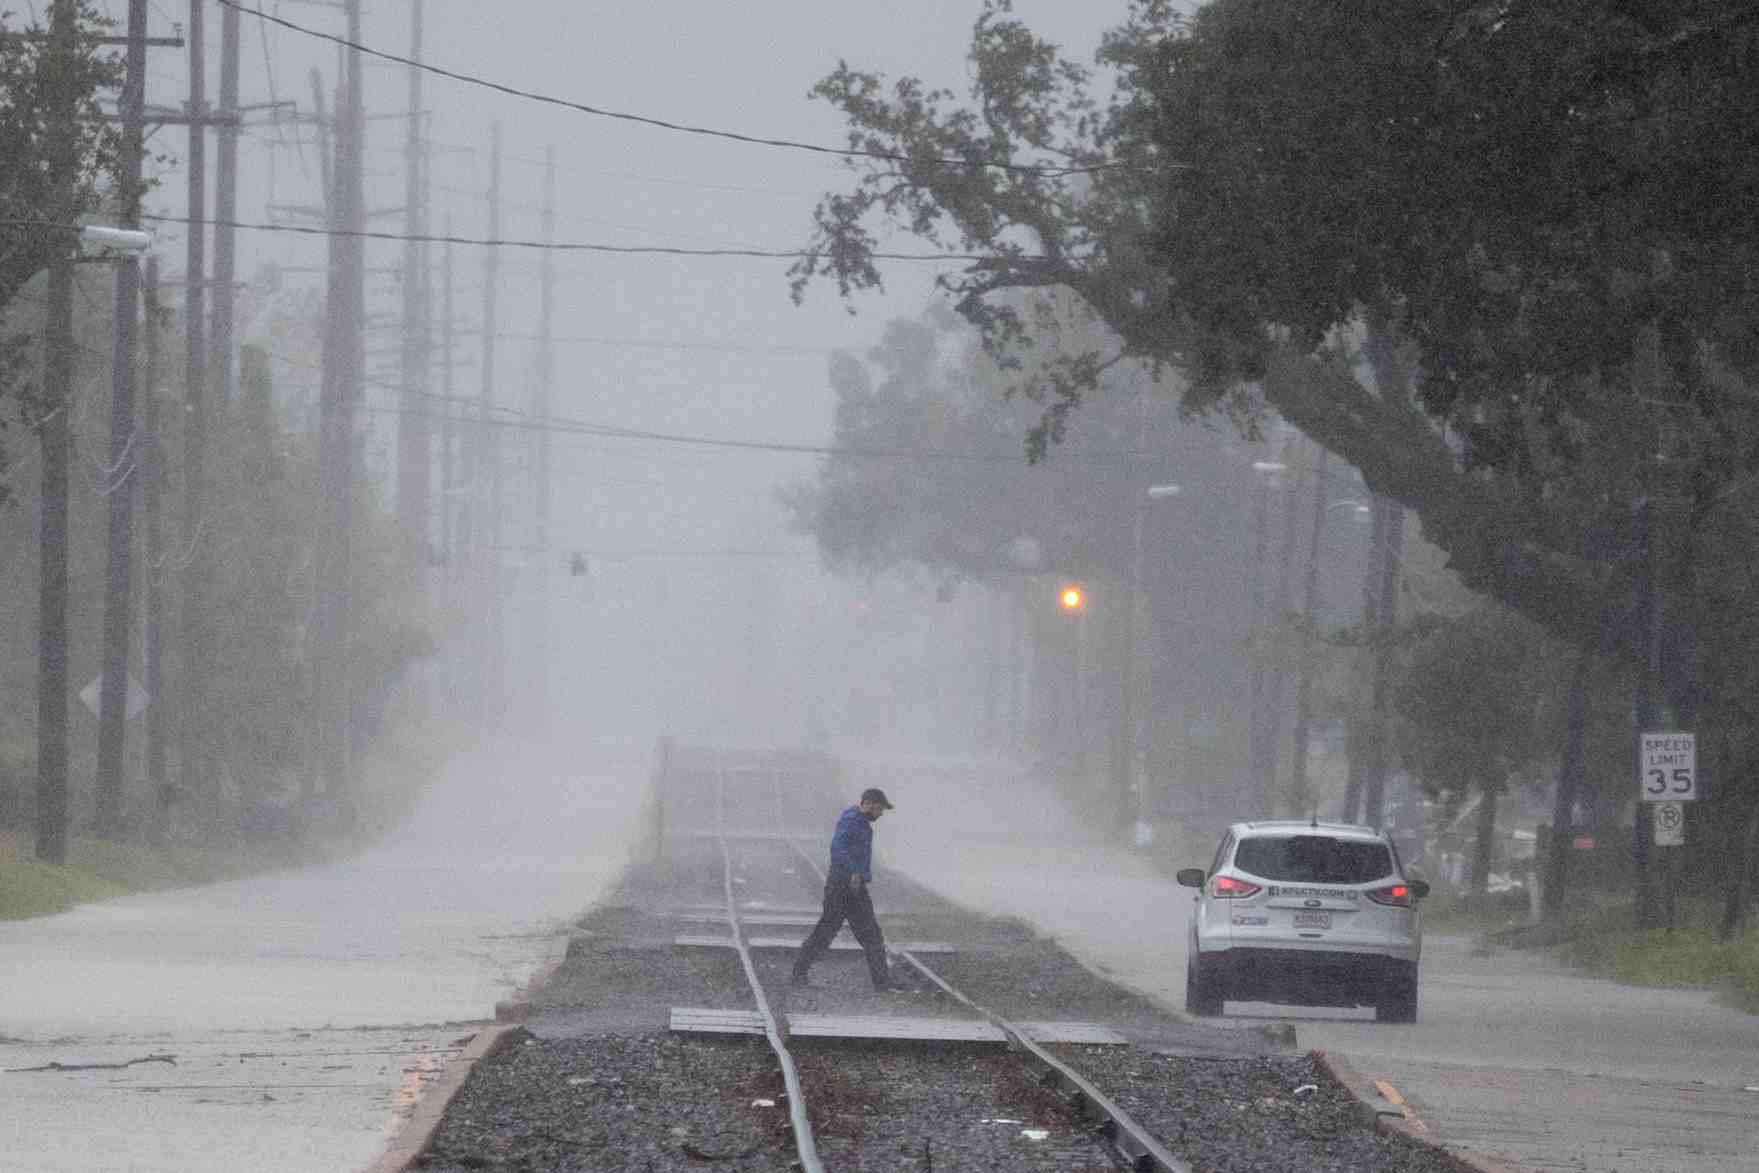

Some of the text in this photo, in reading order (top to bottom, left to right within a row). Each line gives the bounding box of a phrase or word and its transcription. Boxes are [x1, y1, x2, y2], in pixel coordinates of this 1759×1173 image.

[1646, 739, 1692, 752] SPEED
[1650, 754, 1688, 766] LIMIT
[1647, 768, 1692, 794] 35
